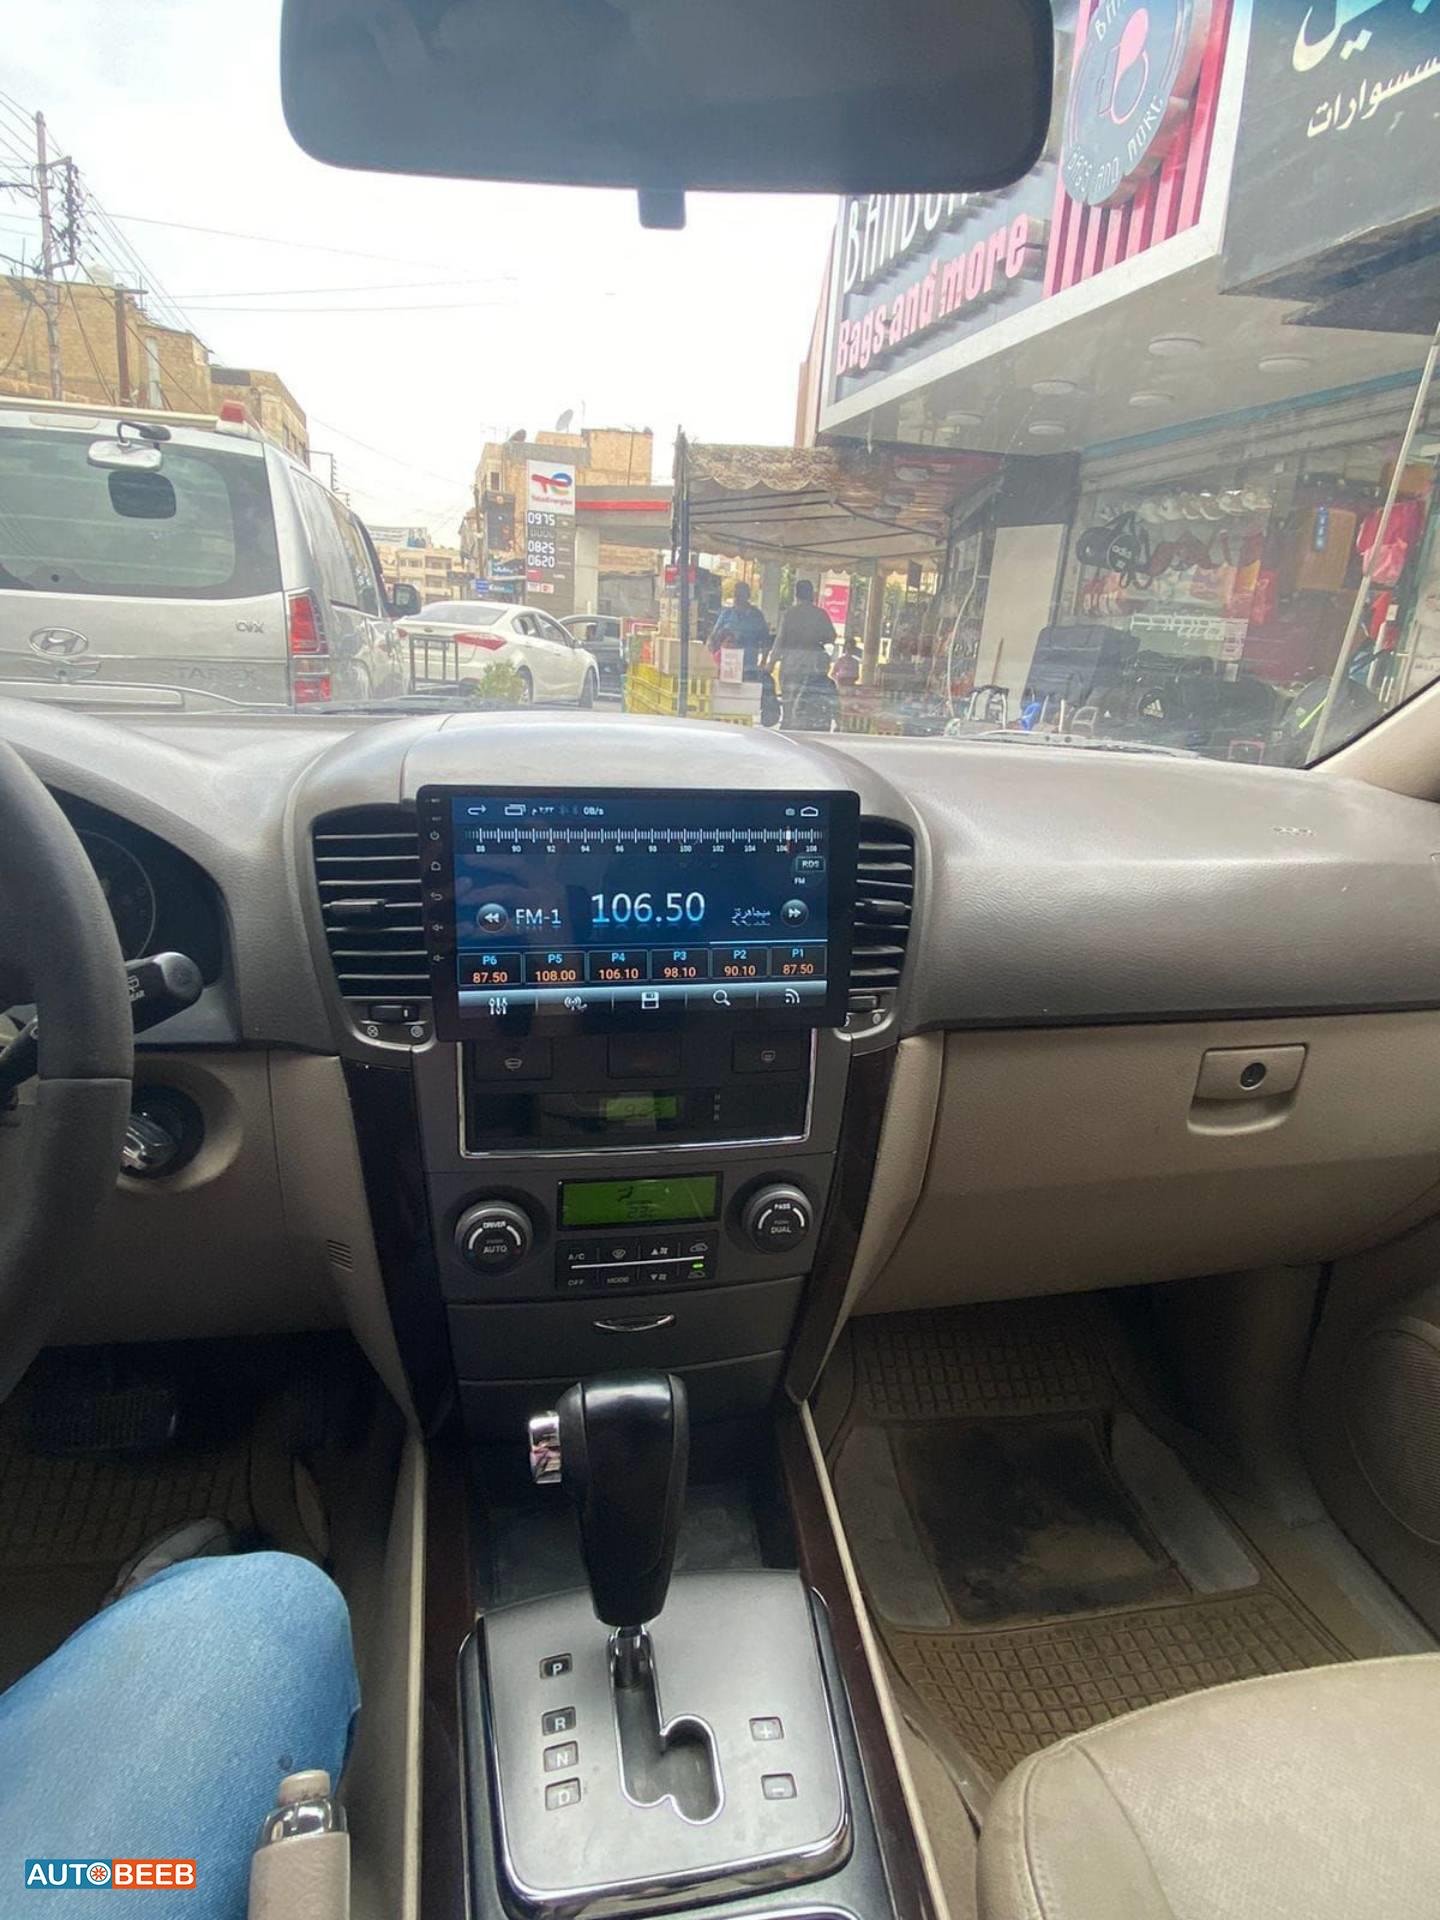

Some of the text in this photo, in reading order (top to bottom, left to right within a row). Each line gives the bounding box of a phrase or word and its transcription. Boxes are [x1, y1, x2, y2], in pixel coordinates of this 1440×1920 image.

[836, 213, 1028, 376] Bags and more
[528, 541, 555, 554] 0825
[528, 554, 555, 568] 0620
[546, 845, 556, 853] 92
[581, 845, 590, 853] 94
[679, 845, 692, 853] 100
[712, 845, 725, 853] 102
[744, 845, 756, 853] 104
[591, 891, 706, 924] 106.50
[515, 908, 561, 925] FM-1
[547, 953, 563, 964] P5
[611, 952, 626, 962] P4
[673, 950, 688, 961] P3
[733, 949, 747, 960] P2
[791, 948, 804, 958] P1
[482, 955, 498, 966] P6
[535, 969, 576, 981] 108.00
[599, 968, 639, 980] 106.10
[663, 966, 697, 978] 98.10
[724, 965, 756, 977] 90.10
[782, 963, 814, 975] 87.50
[472, 971, 508, 983] 87.50
[483, 1245, 507, 1254] AUTO
[607, 1276, 630, 1284] MODE
[552, 1663, 563, 1676] P
[555, 1717, 566, 1731] R
[556, 1752, 569, 1767] N
[558, 1790, 570, 1806] D
